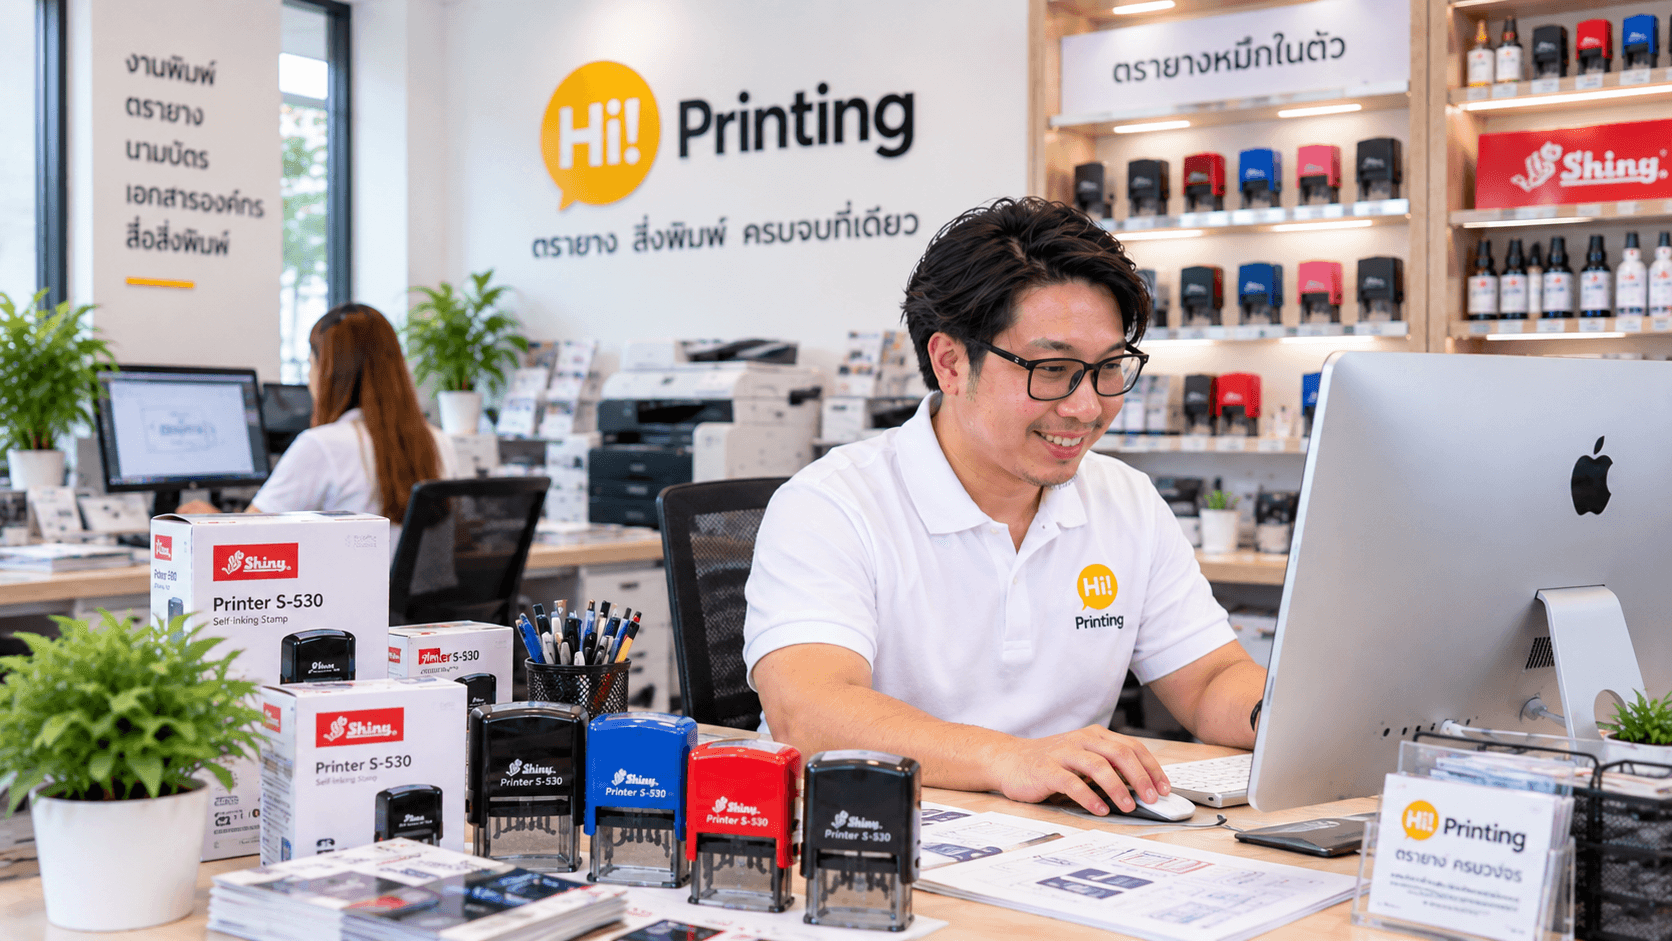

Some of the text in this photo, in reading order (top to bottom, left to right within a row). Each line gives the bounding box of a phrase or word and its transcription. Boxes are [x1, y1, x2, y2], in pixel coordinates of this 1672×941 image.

[1113, 29, 1346, 83] ตรายางหมึกในตัว
[126, 53, 216, 86] งานพิมพ์
[125, 96, 204, 126] ตรายาง
[558, 82, 915, 170] Hi! Printing
[126, 139, 209, 169] นามบัตร
[126, 183, 265, 218] เอกสารองค์กร
[126, 216, 229, 256] สื่อสิ่งพิมพ์
[532, 201, 919, 258] ตรายาง สิ่งพิมพ์ ครบจบที่เดียว
[243, 555, 287, 573] Shiny
[1082, 575, 1113, 597] Hi!
[213, 593, 324, 612] Printer S-530
[261, 615, 289, 625] Stamp
[1075, 613, 1124, 630] Printing
[315, 754, 412, 774] Printer S-530
[521, 763, 554, 776] Shiny
[500, 776, 563, 787] Printer S-530
[605, 786, 667, 798] Printer S-530
[706, 814, 769, 827] Printer S-530
[824, 829, 859, 840] Printer
[1406, 809, 1527, 853] Hi! Printing
[1395, 848, 1448, 868] ตรายาง
